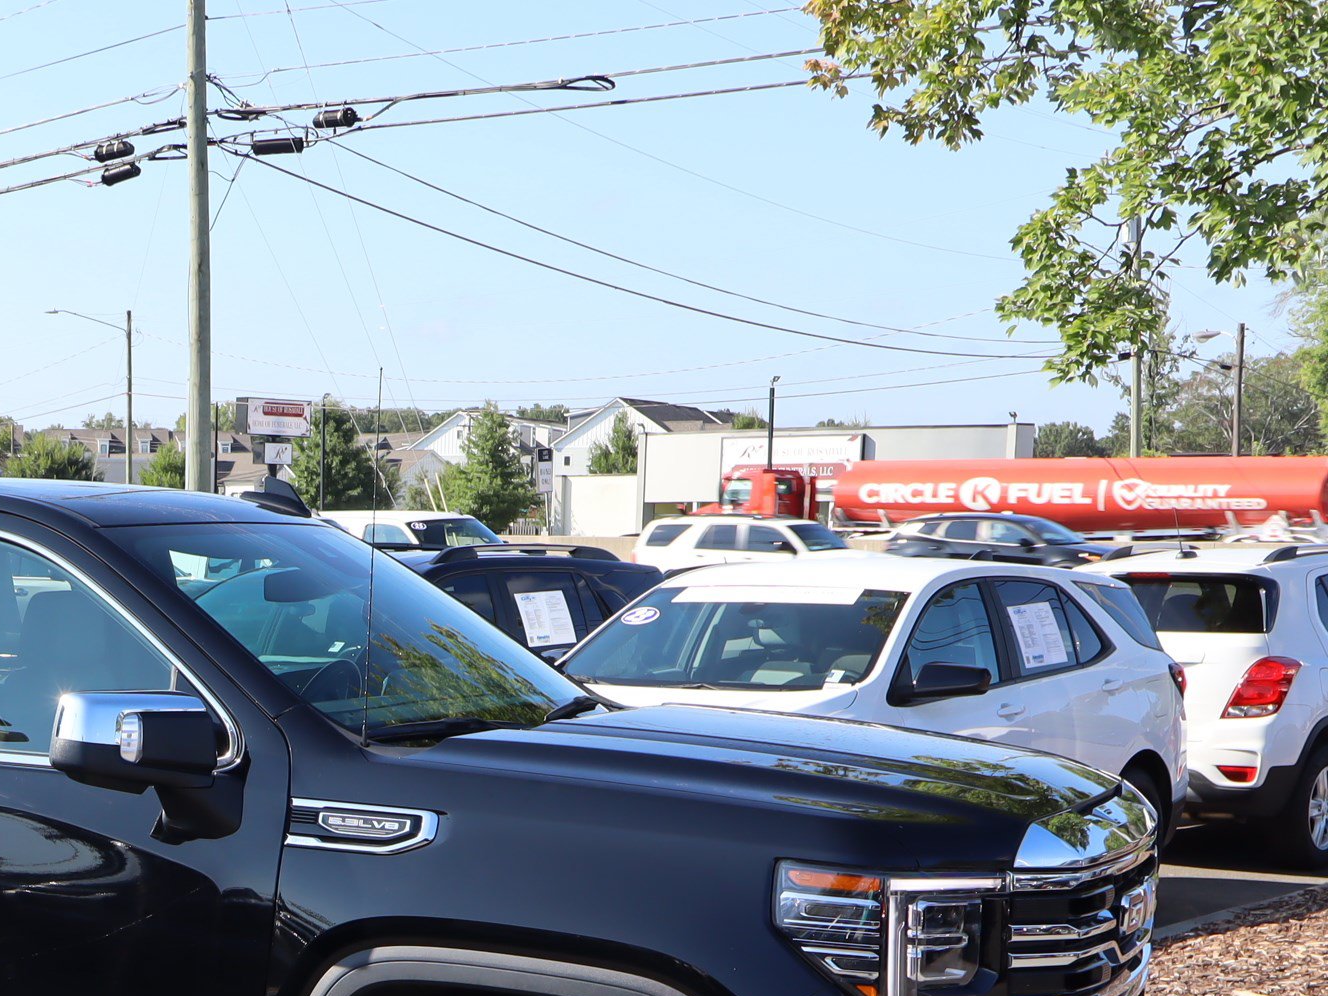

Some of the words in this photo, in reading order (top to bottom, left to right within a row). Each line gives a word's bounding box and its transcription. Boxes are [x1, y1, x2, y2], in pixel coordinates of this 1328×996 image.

[858, 482, 957, 504] CIRCLE
[1007, 482, 1093, 504] FUEL
[1147, 484, 1232, 497] QUALITY
[1147, 498, 1267, 510] GUARANTEED
